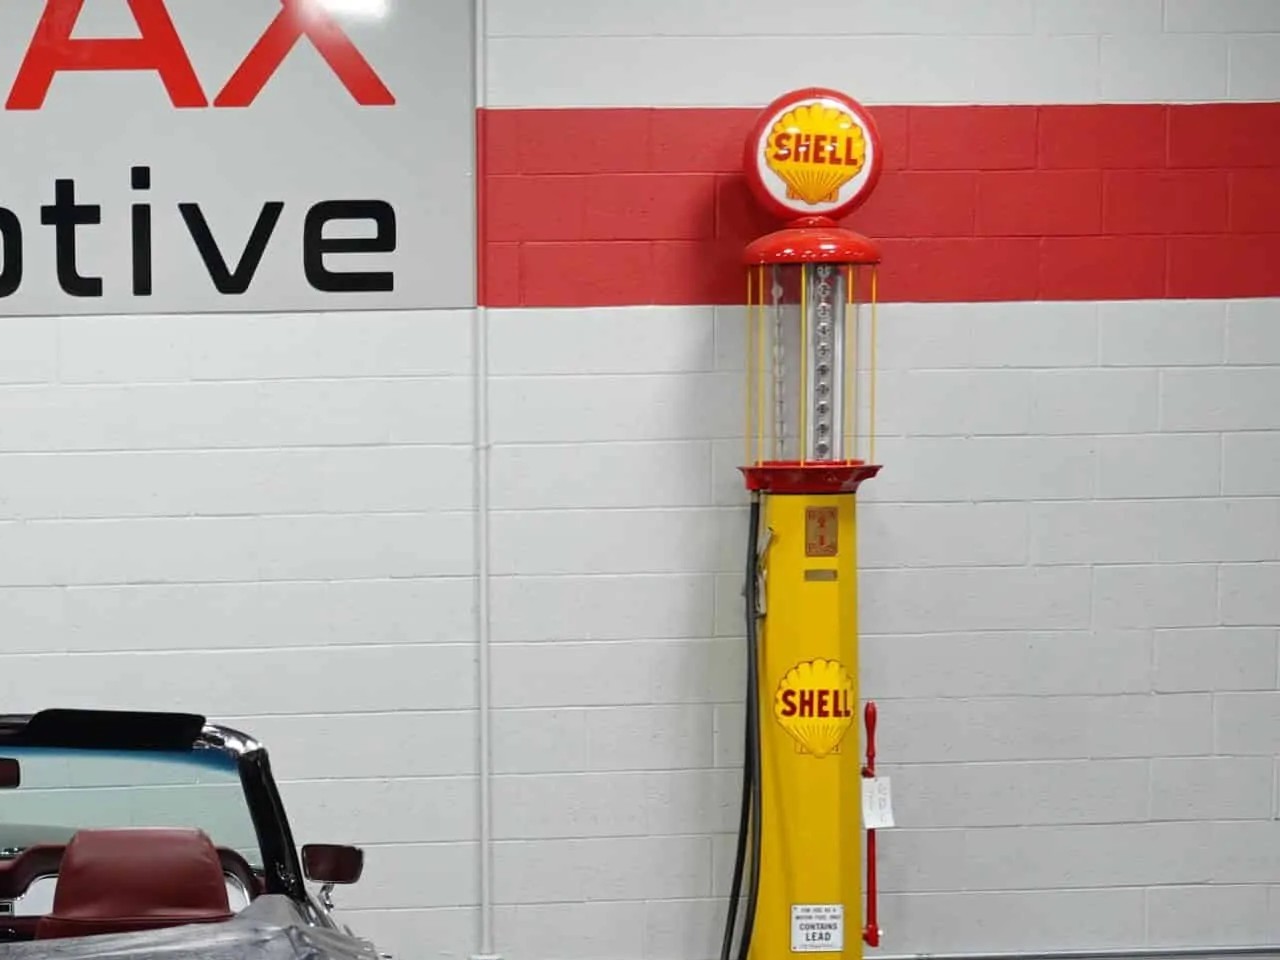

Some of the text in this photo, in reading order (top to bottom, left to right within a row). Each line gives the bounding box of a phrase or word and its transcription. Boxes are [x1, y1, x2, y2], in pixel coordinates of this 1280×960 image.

[773, 132, 858, 166] SHELL
[781, 688, 852, 718] SHELL
[806, 931, 831, 942] LEAD
